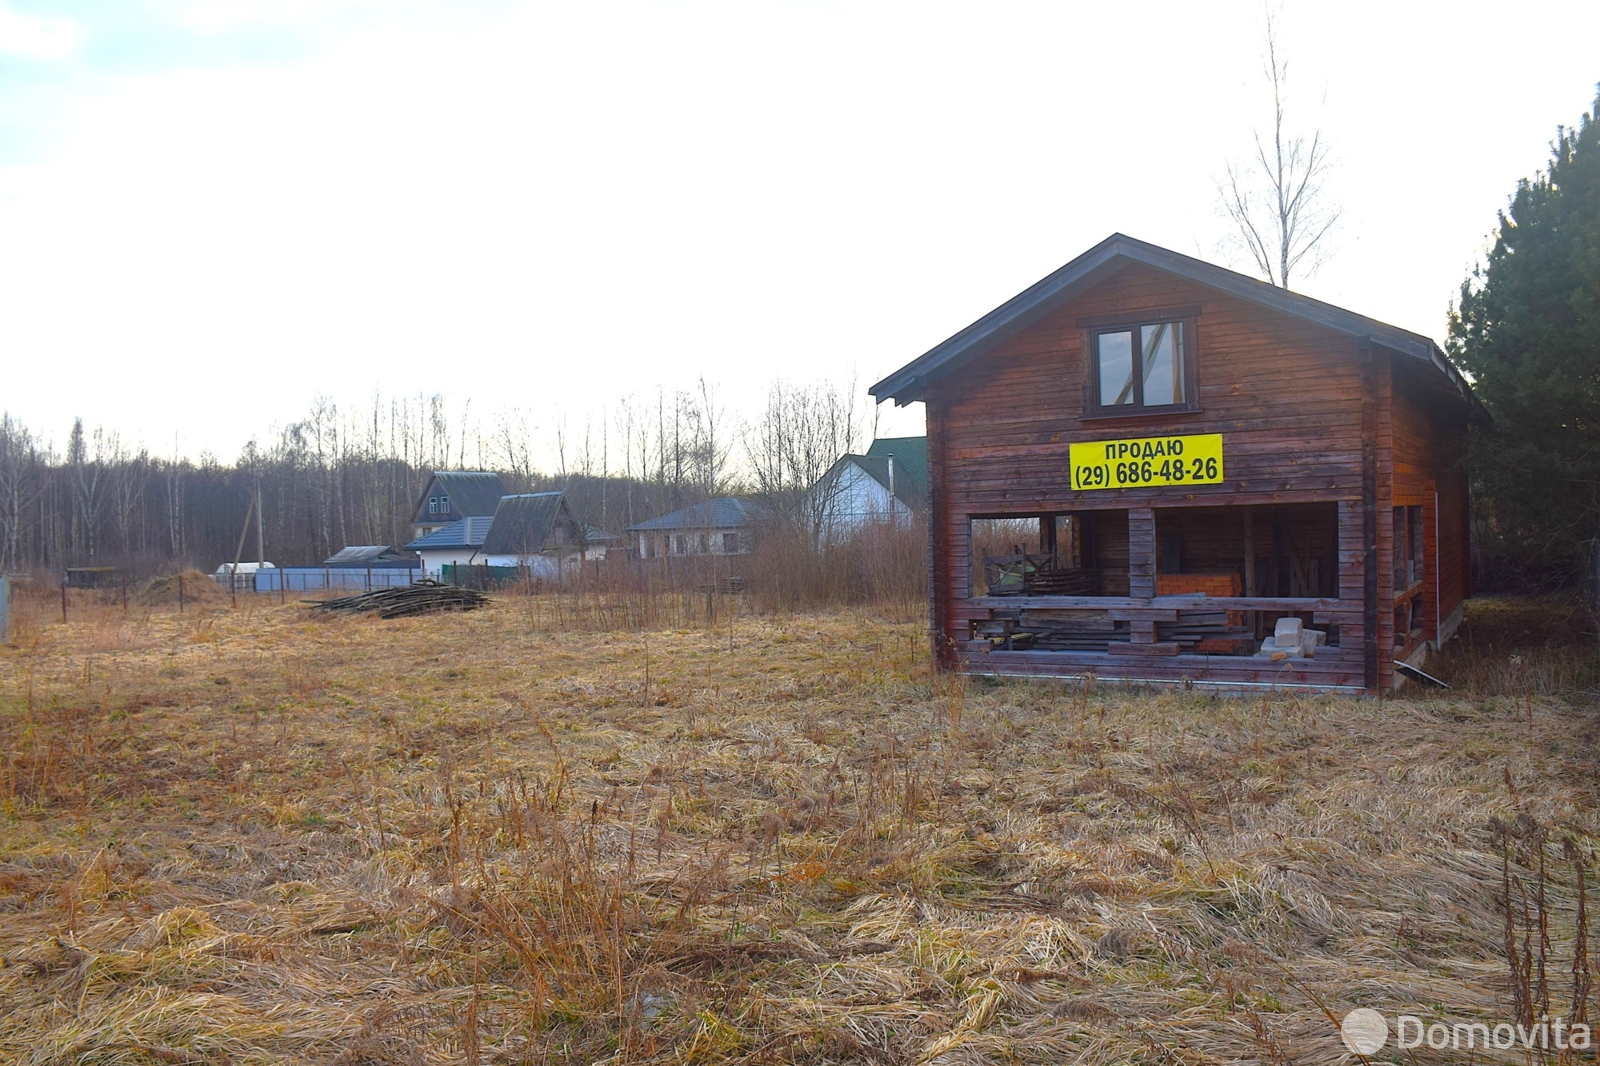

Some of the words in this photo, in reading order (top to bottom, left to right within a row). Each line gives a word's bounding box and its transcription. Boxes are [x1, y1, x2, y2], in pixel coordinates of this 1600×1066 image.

[1105, 439, 1184, 461] ПРОДАЮ
[1075, 463, 1110, 489] (29)
[1116, 457, 1218, 484] 686-48-26
